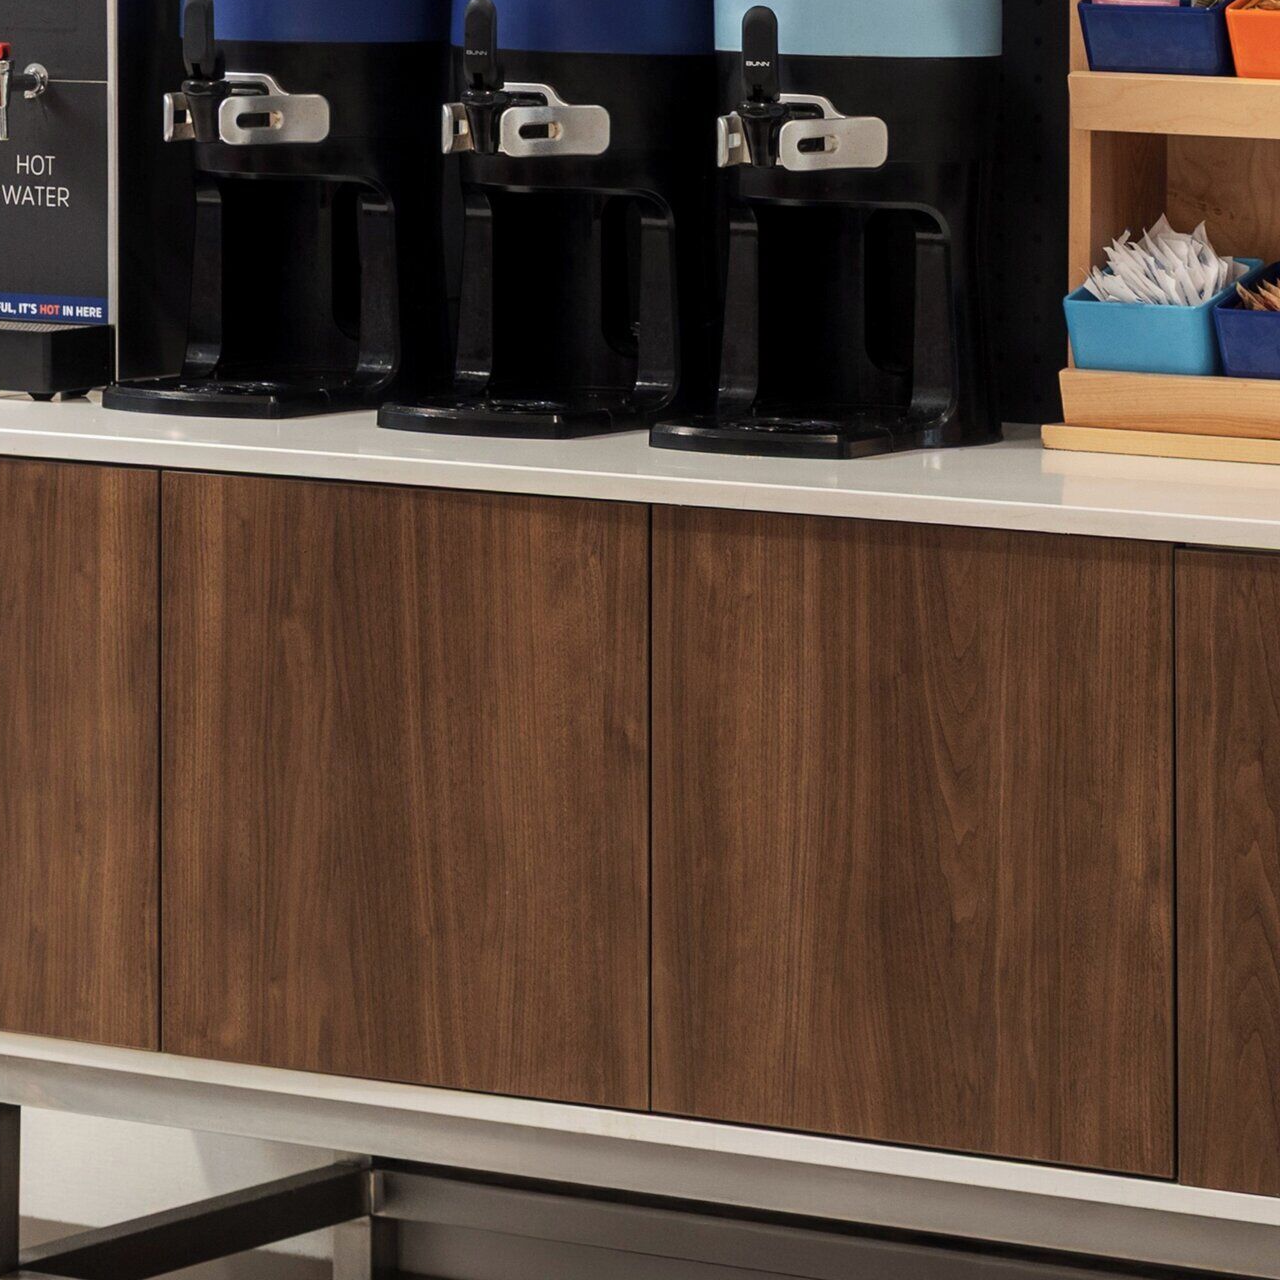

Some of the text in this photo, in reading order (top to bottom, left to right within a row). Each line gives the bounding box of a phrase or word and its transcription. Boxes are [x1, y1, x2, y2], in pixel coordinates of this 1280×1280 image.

[16, 154, 56, 177] HOT
[1, 184, 70, 208] WATER
[18, 302, 38, 314] IT'S
[39, 304, 60, 315] HOT
[62, 305, 74, 316] IN
[75, 306, 102, 318] HERE
